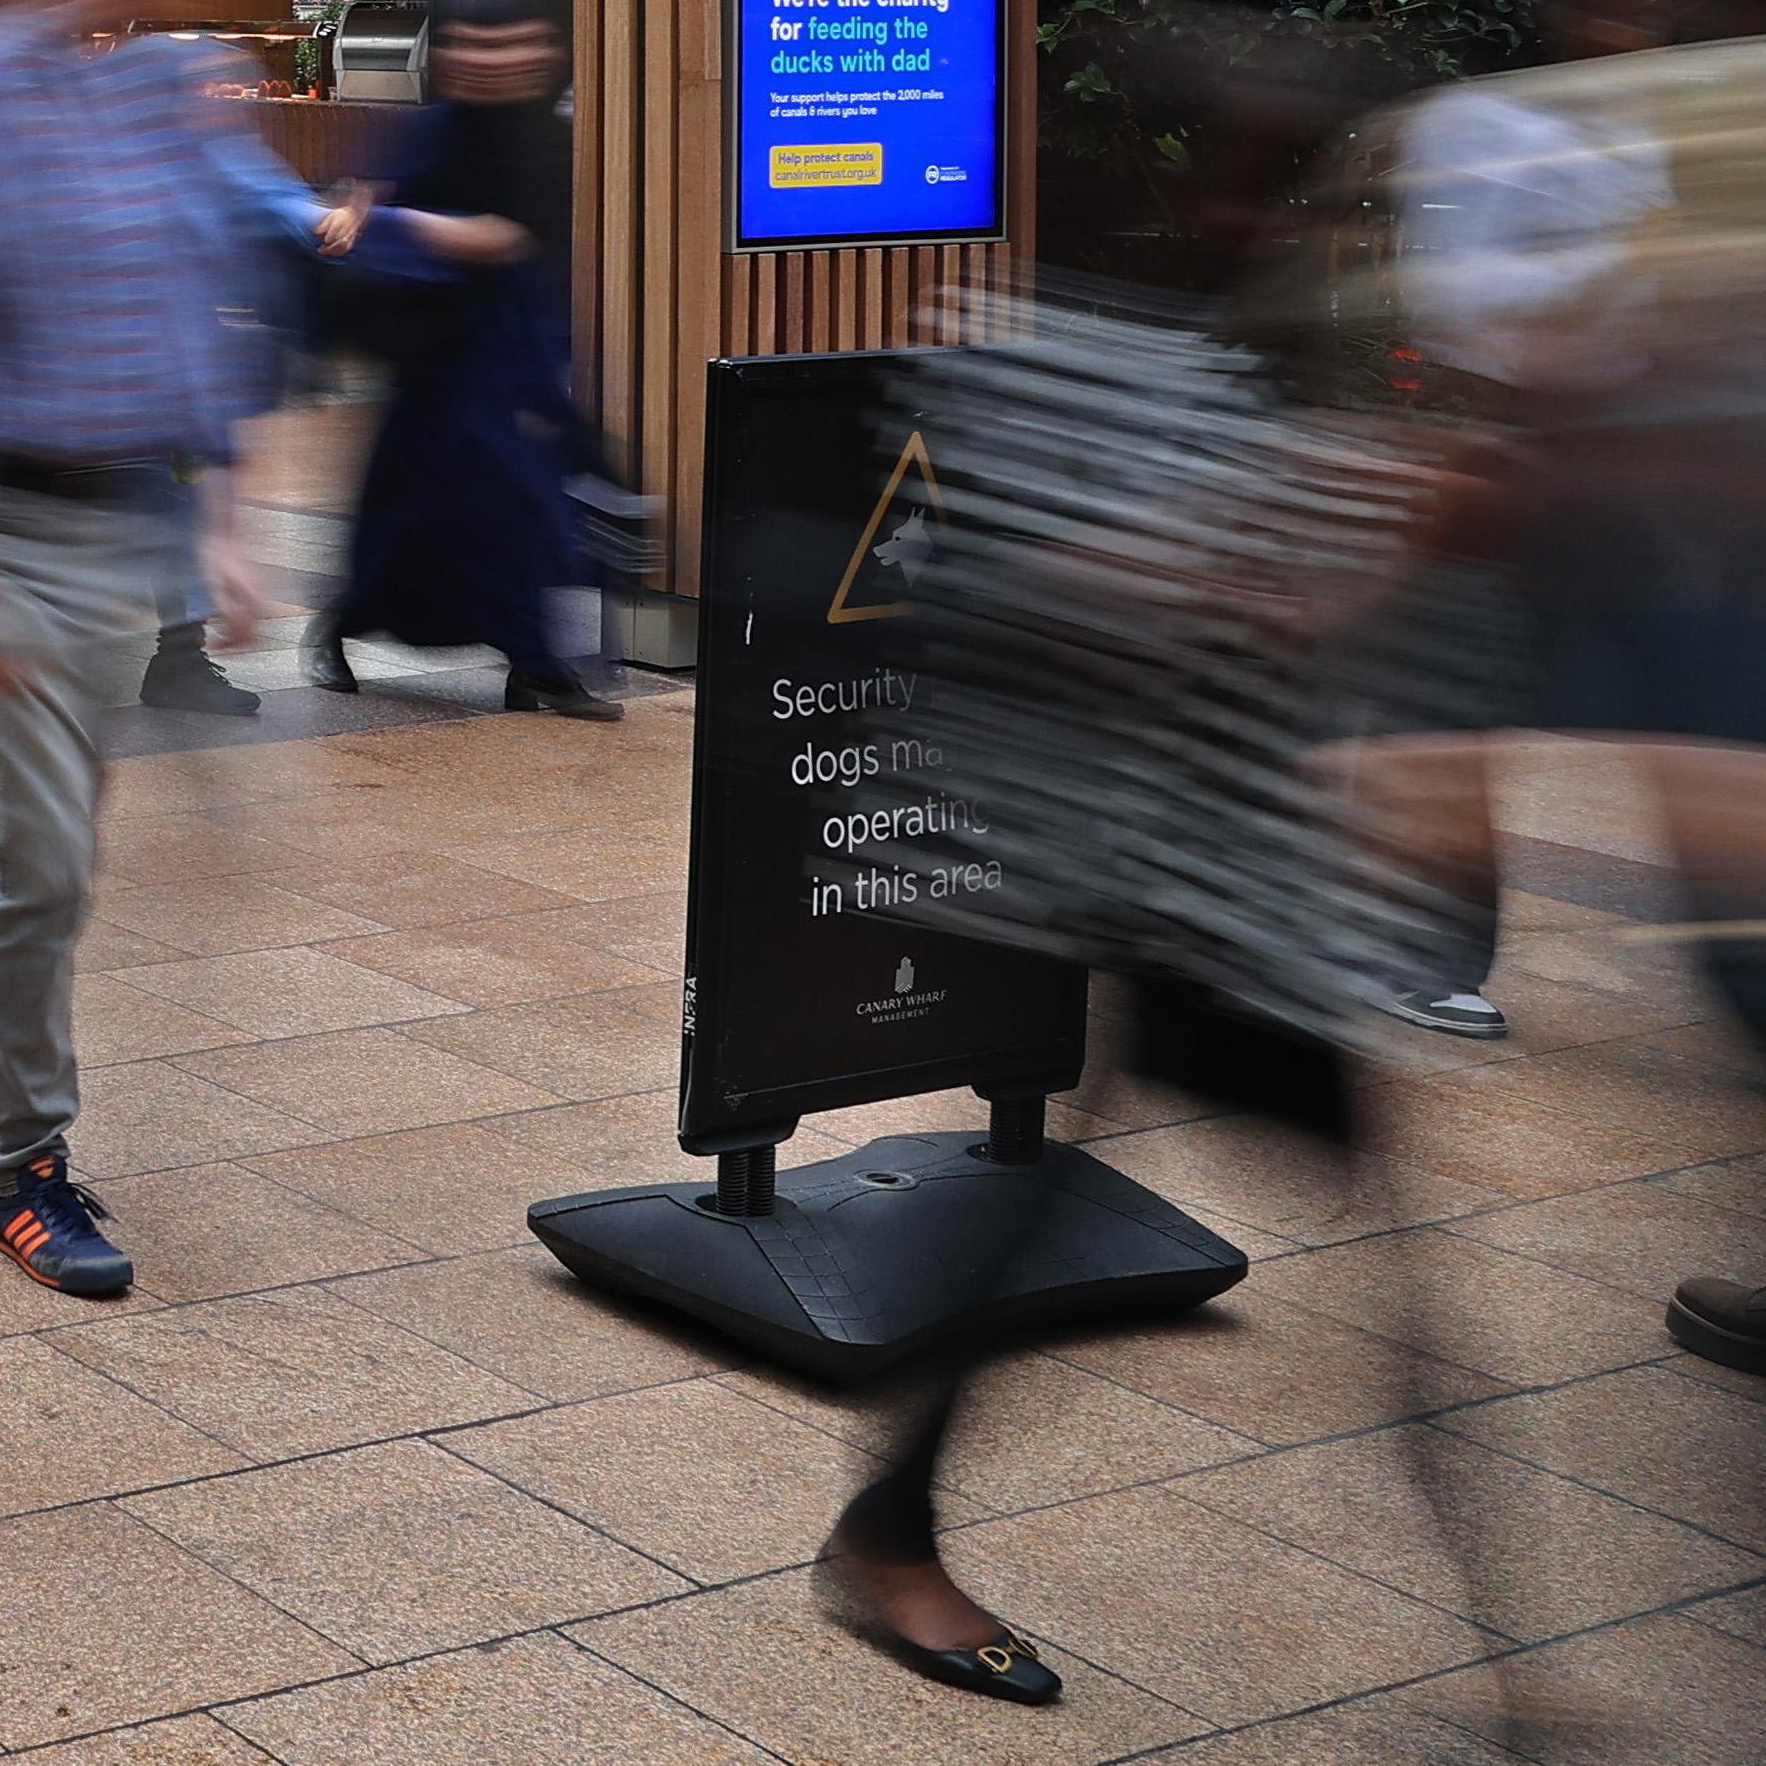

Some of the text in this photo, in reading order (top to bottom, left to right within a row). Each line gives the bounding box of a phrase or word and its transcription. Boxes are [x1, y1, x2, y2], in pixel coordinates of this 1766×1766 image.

[771, 16, 927, 45] for feeding the
[771, 48, 930, 73] ducks with dad
[770, 89, 944, 104] Your support helps protect the 2,000 miles
[770, 105, 877, 118] of canals & rivers you love
[778, 151, 874, 165] Help protect canals
[772, 668, 917, 719] Security
[791, 738, 956, 786] dogs ma
[812, 860, 1002, 916] in this area
[856, 990, 947, 1015] CANARY WHARF
[871, 1008, 929, 1023] MANAGEMENT
